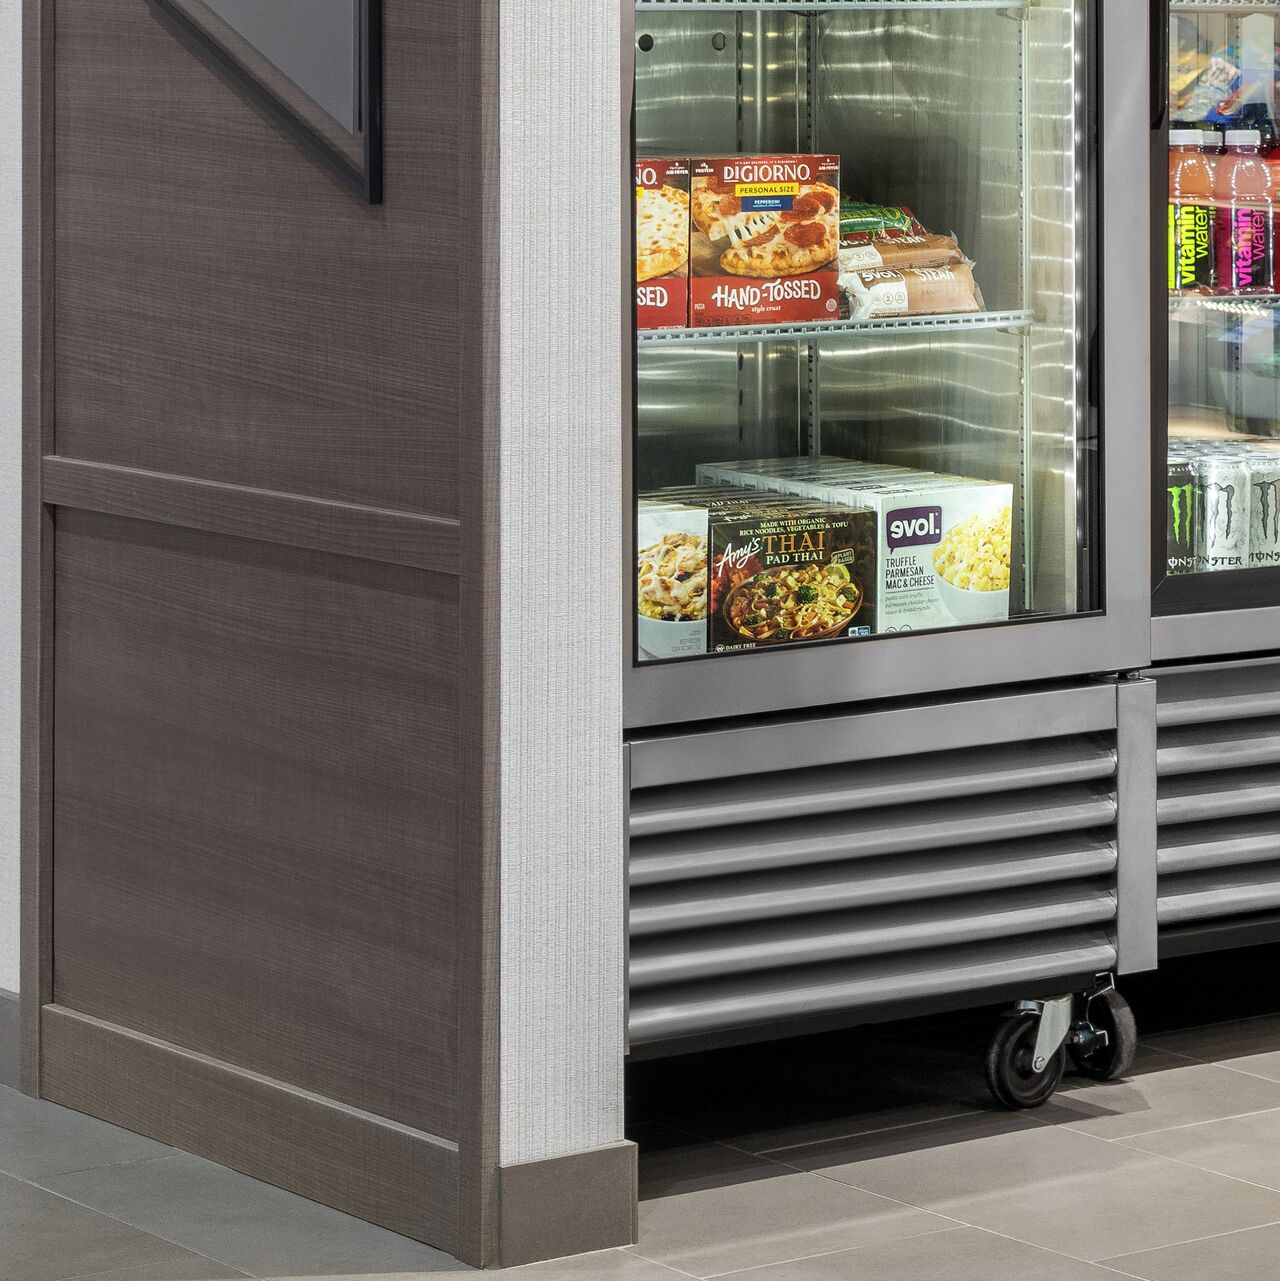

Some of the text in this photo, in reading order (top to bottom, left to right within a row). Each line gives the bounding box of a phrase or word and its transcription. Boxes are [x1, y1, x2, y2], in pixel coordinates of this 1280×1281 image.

[1180, 205, 1210, 285] vitamin water
[1239, 208, 1266, 287] vitamin water
[711, 278, 821, 311] HAND-TOSSED
[779, 519, 796, 527] WITH
[797, 518, 826, 526] ORGANIC
[762, 531, 826, 555] THAI
[766, 551, 823, 565] PAD THAI
[885, 556, 916, 568] TRUFFLE
[885, 567, 924, 579] PARMESAN
[885, 579, 902, 590] MAC
[910, 575, 935, 587] CHEESE
